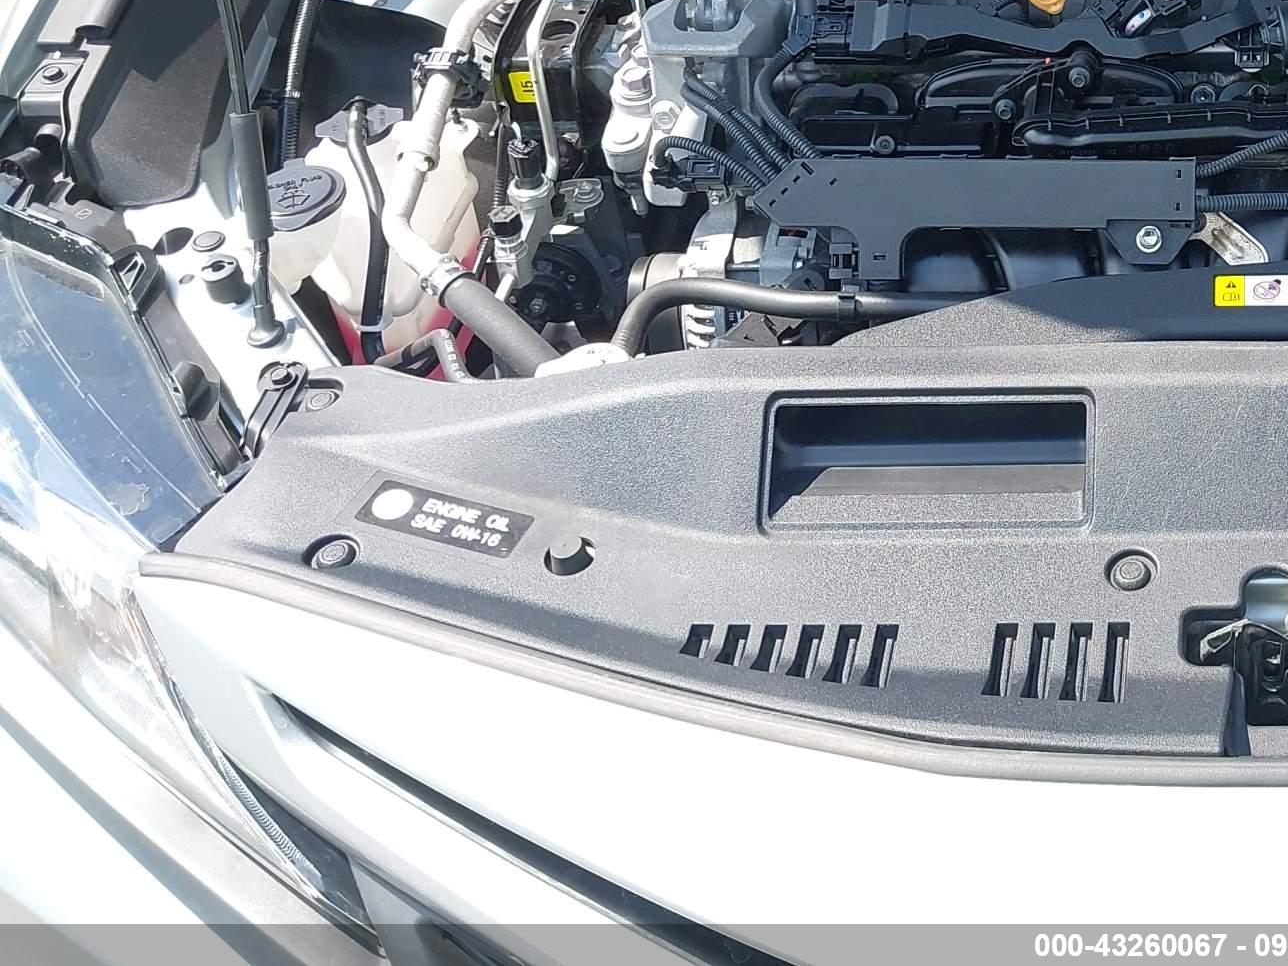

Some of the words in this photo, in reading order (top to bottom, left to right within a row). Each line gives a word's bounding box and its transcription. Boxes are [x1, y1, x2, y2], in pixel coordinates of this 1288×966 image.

[410, 514, 447, 534] SAE
[450, 524, 503, 548] 0W-16
[422, 498, 482, 524] ENGINE
[484, 513, 512, 533] OIL
